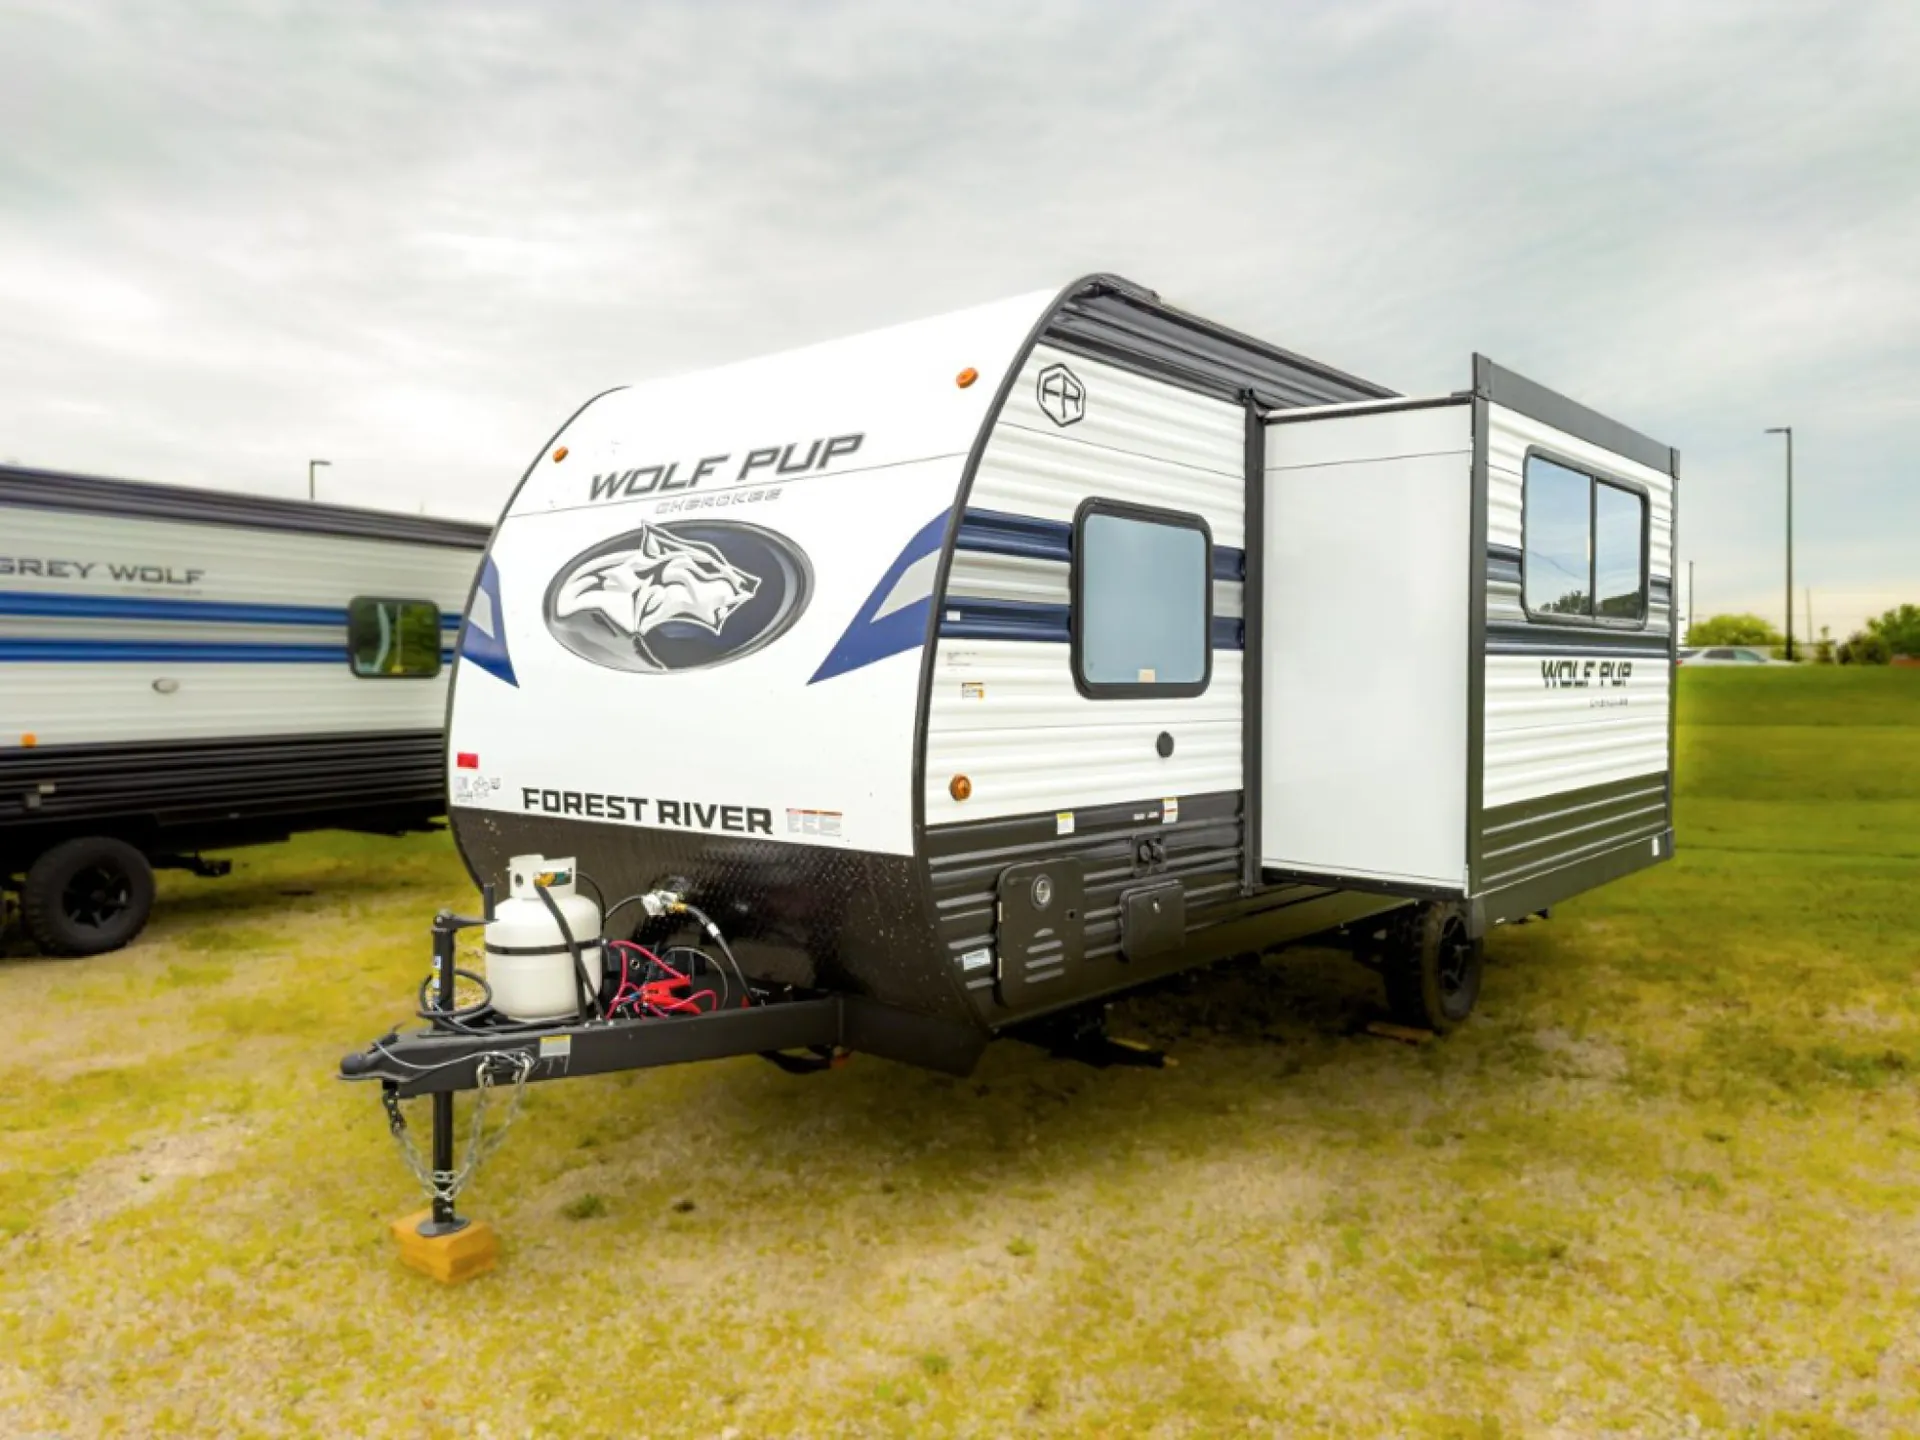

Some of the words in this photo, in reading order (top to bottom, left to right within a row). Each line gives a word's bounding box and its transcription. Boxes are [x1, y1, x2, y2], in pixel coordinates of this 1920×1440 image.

[589, 454, 731, 501] WOLF
[736, 432, 865, 482] PUP
[654, 487, 783, 514] CHEROKEE
[0, 557, 97, 579] GREY
[107, 562, 205, 585] WOLF
[1541, 660, 1596, 689] WOLF
[1599, 661, 1632, 688] PUP
[521, 787, 649, 823] FOREST
[656, 798, 774, 835] RIVER
